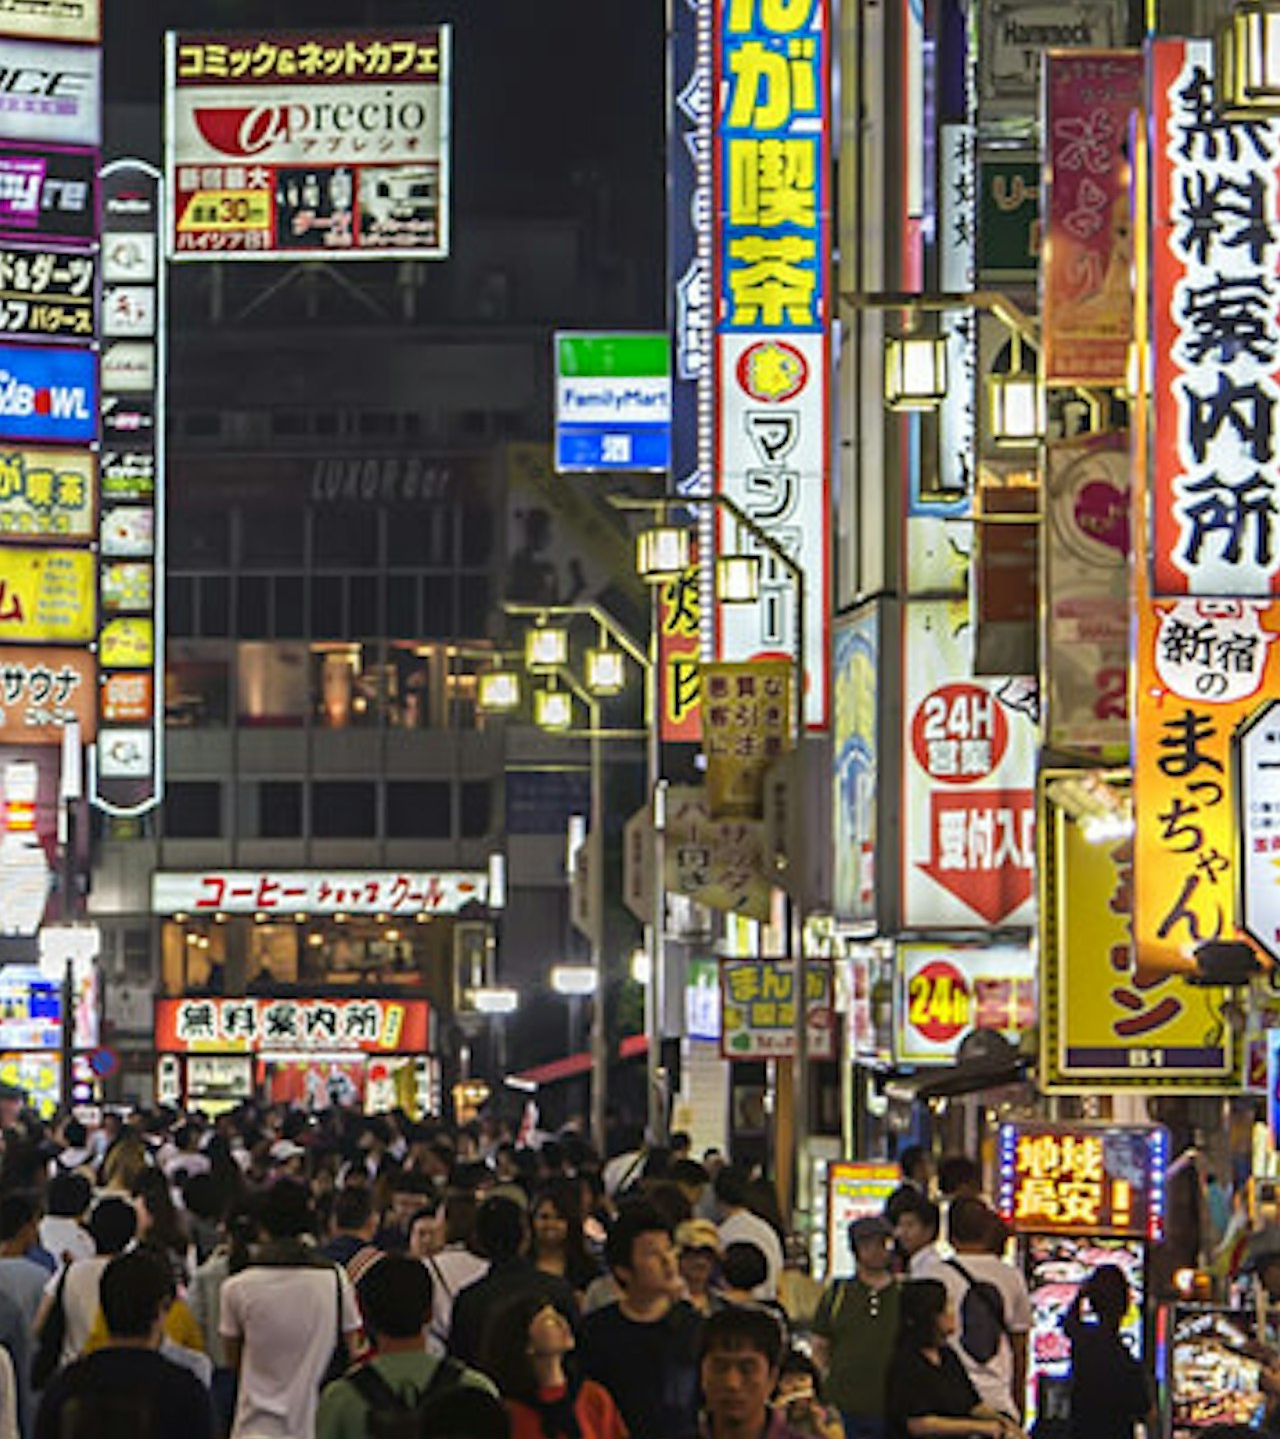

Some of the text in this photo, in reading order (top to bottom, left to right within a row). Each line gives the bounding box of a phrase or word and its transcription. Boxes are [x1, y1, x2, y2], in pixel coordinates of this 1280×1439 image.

[179, 43, 439, 77] コミック&ネットカフェ
[1178, 66, 1280, 567] 無料案内所
[564, 388, 668, 411] FamilyMart
[924, 696, 994, 738] 24H
[197, 879, 304, 908] コーヒー
[176, 999, 380, 1039] 無料案内所
[910, 975, 968, 1023] 24h
